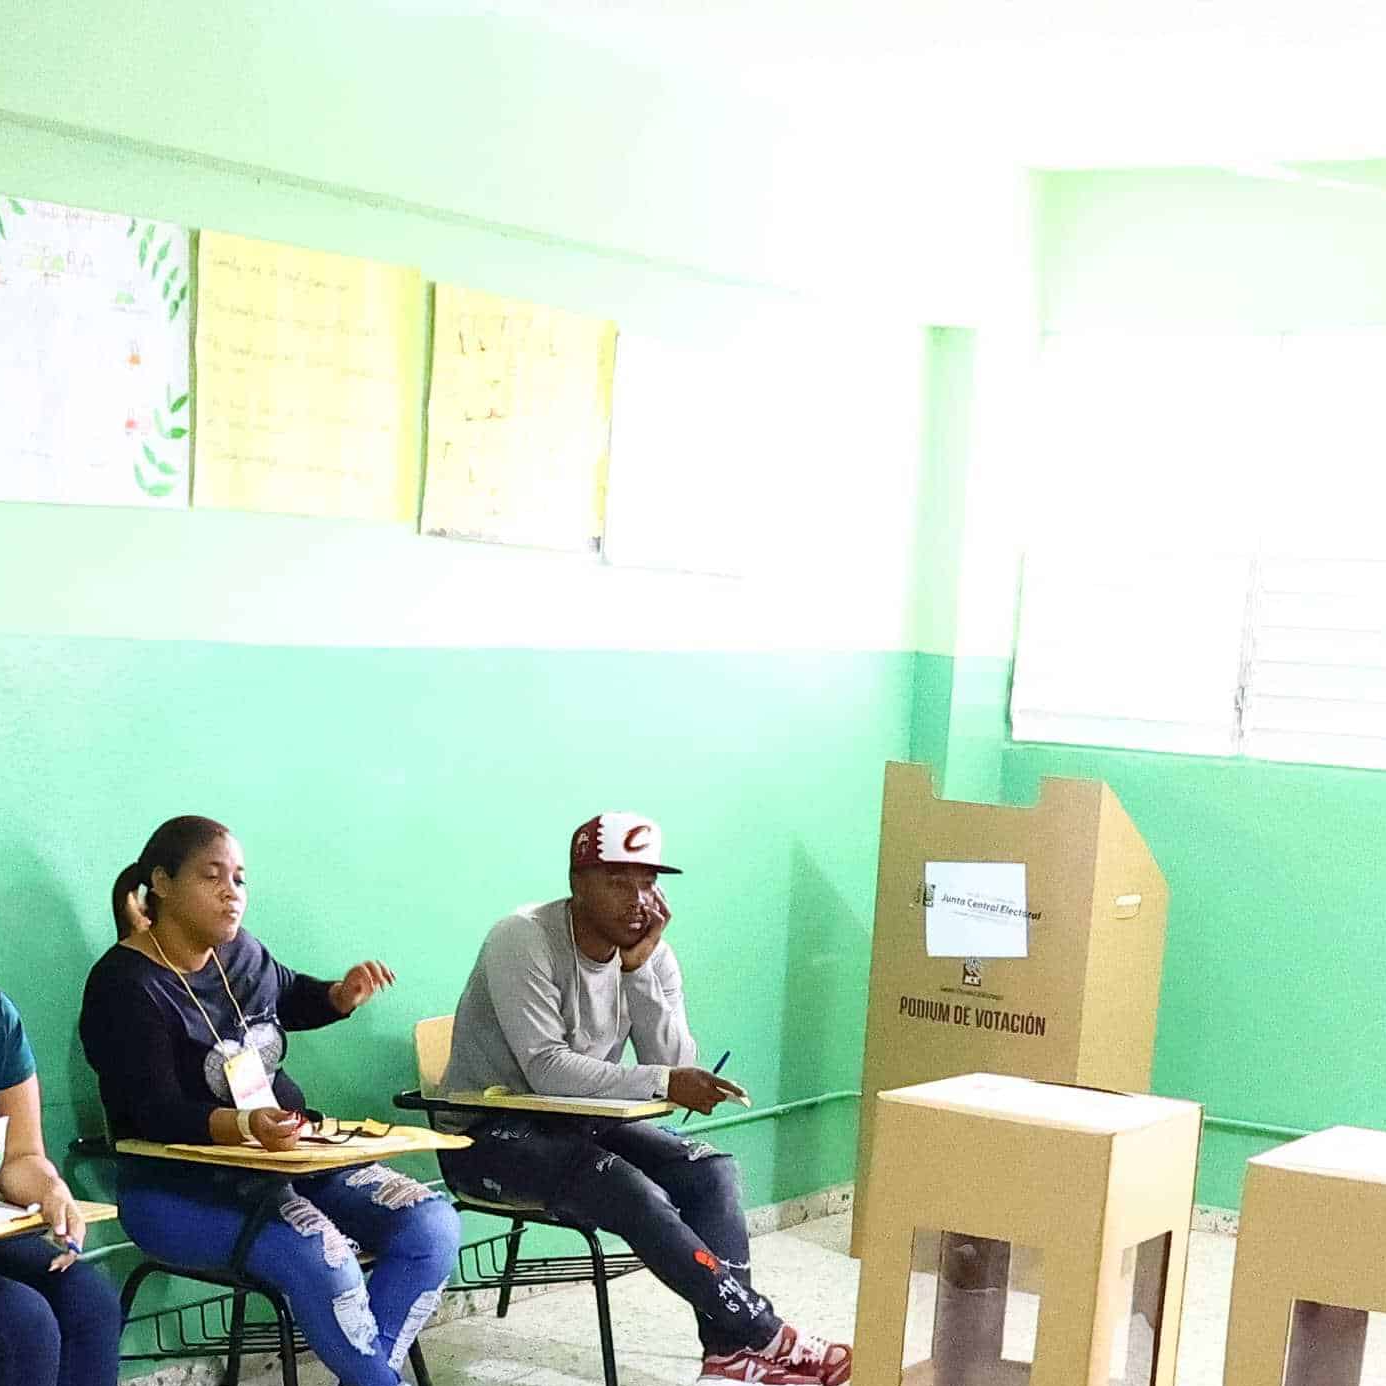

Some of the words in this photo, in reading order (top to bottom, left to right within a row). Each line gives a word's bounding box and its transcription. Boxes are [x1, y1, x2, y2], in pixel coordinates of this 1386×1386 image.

[623, 825, 651, 854] C
[941, 893, 966, 907] Junta
[966, 899, 1000, 913] Central
[999, 905, 1042, 921] Electoral
[899, 995, 951, 1023] PODIUM
[953, 1004, 971, 1026] DE
[974, 1008, 1046, 1037] VOTACIÓN
